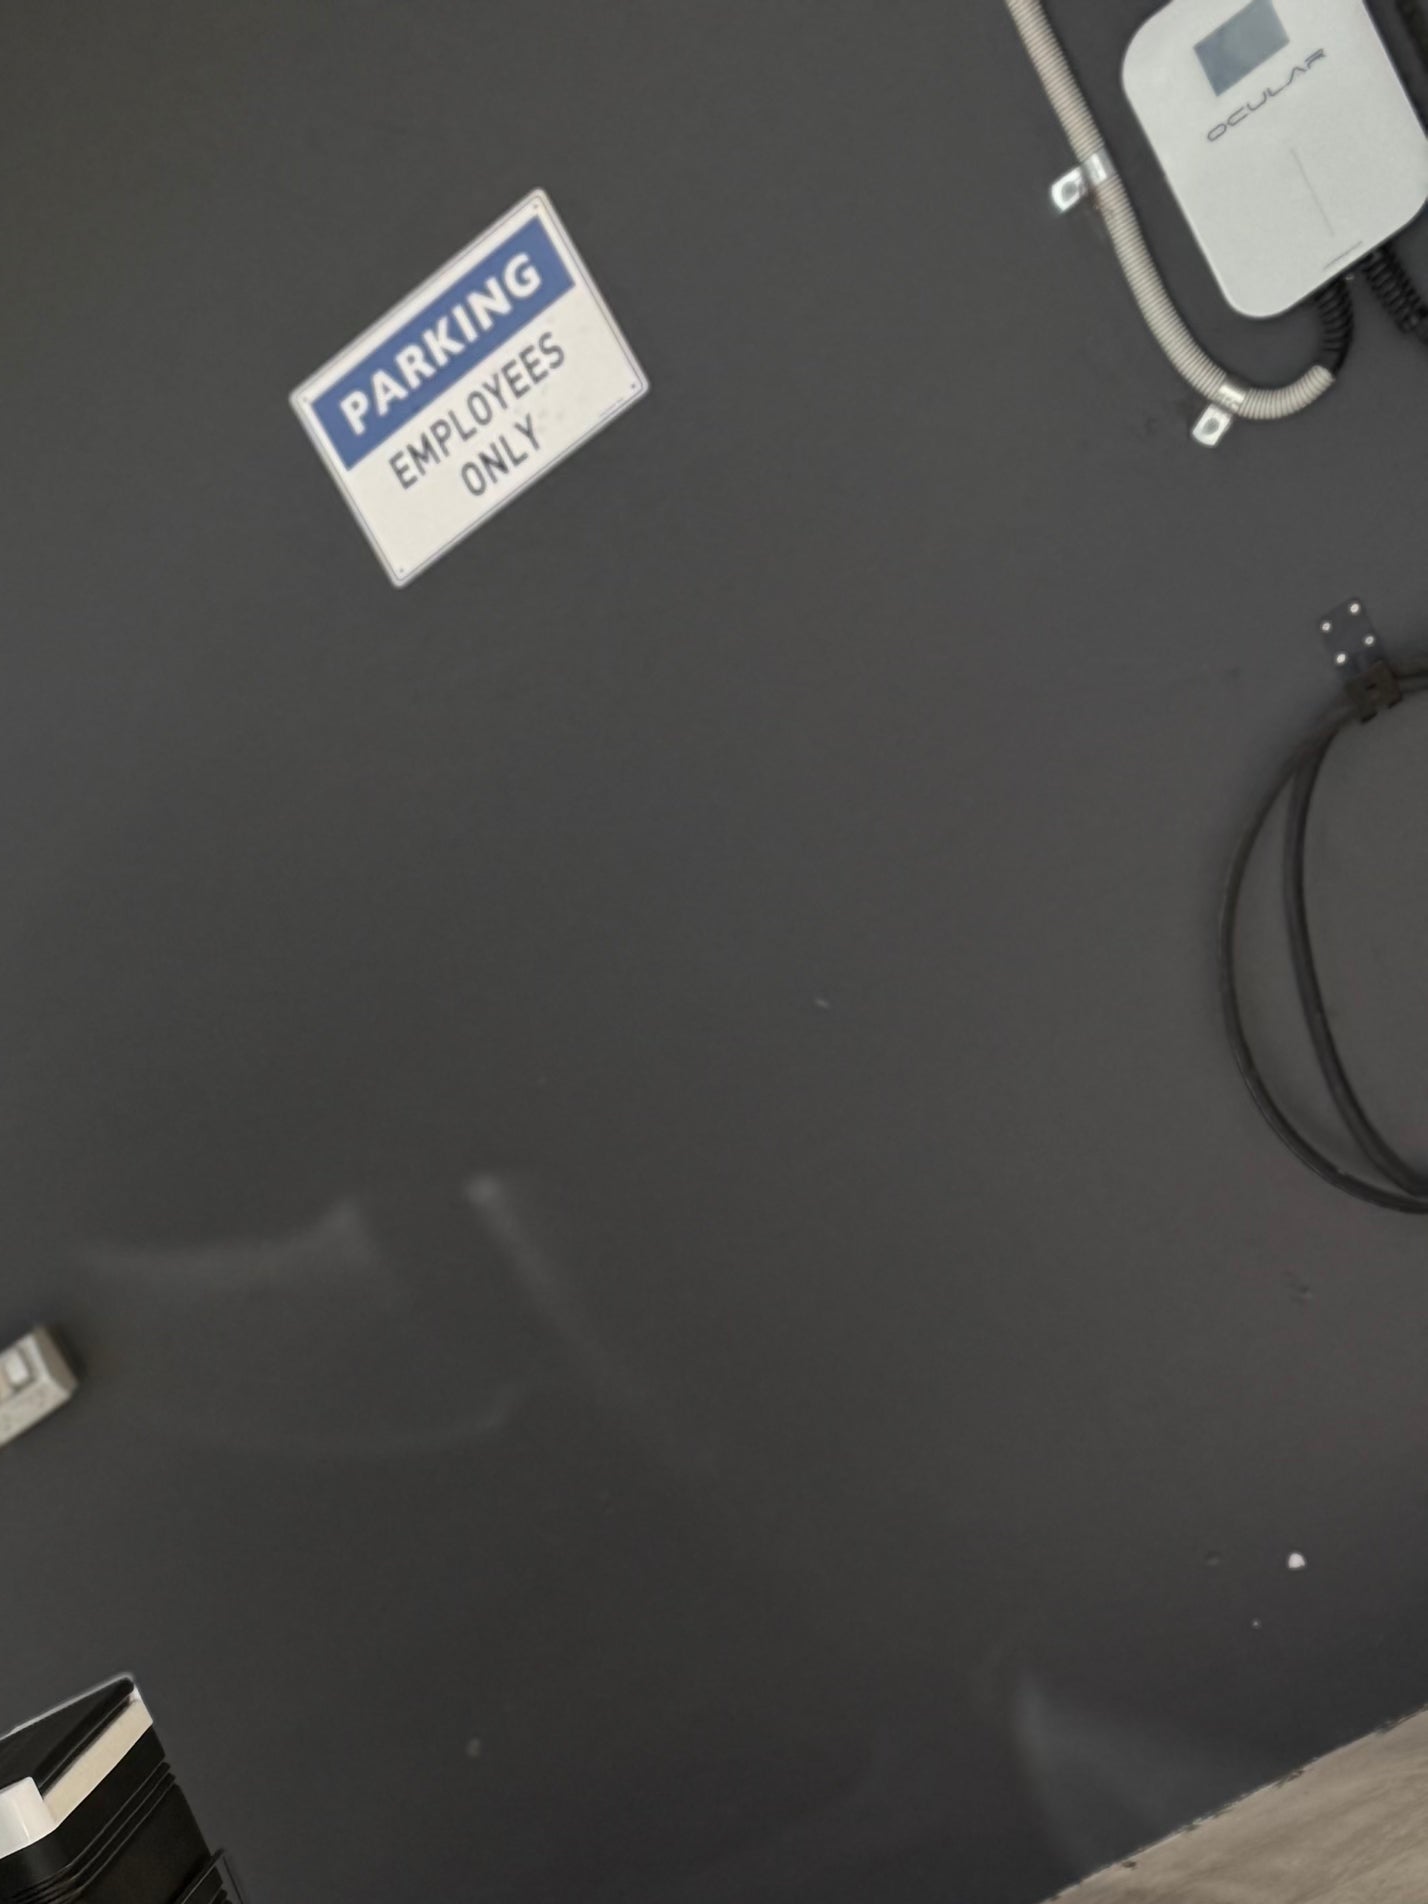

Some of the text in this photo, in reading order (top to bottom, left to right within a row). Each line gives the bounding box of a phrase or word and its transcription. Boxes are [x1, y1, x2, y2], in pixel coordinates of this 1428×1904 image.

[1206, 47, 1327, 142] OCULAR
[339, 252, 542, 436] PARKING
[388, 331, 565, 490] EMPLOYEES
[460, 412, 541, 497] ONLY
